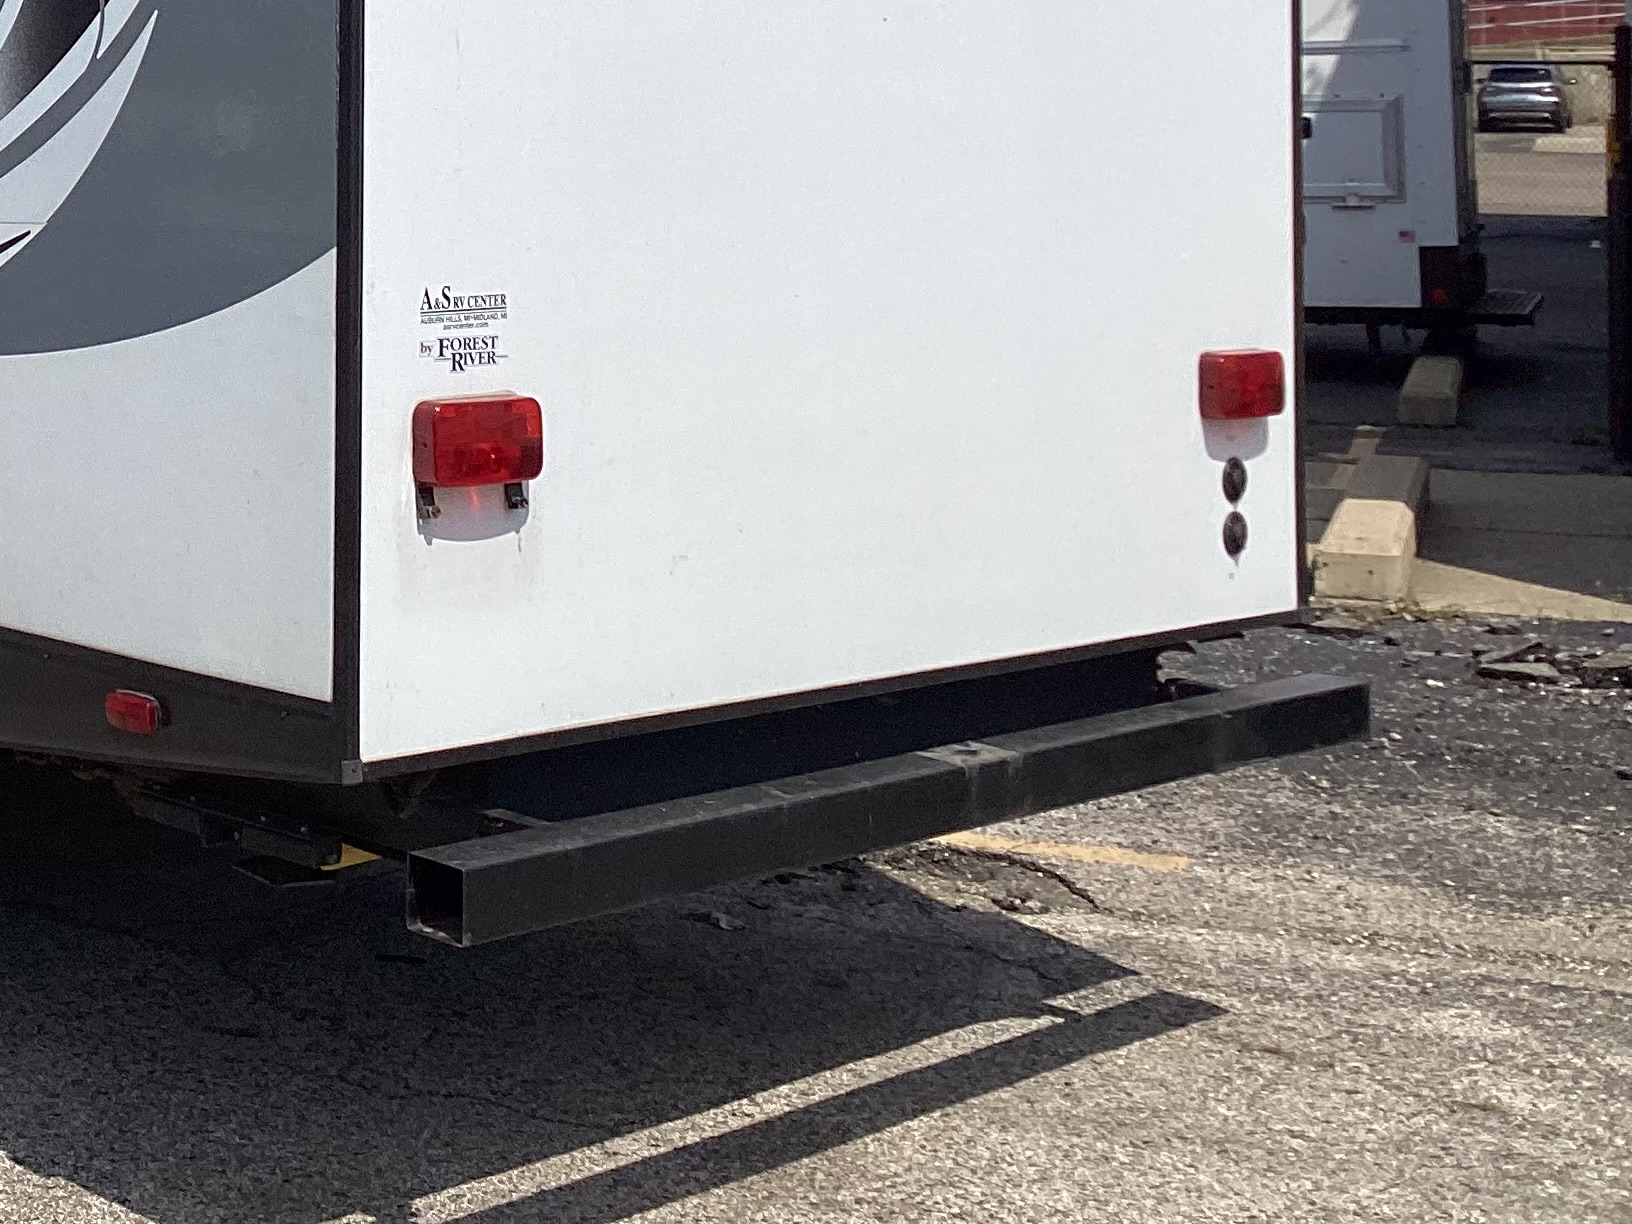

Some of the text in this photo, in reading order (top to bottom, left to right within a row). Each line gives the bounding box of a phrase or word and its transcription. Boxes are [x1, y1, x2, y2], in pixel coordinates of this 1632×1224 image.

[420, 286, 507, 310] A&S RV CENTER
[420, 335, 498, 358] by FOREST
[451, 350, 497, 372] RIVER
